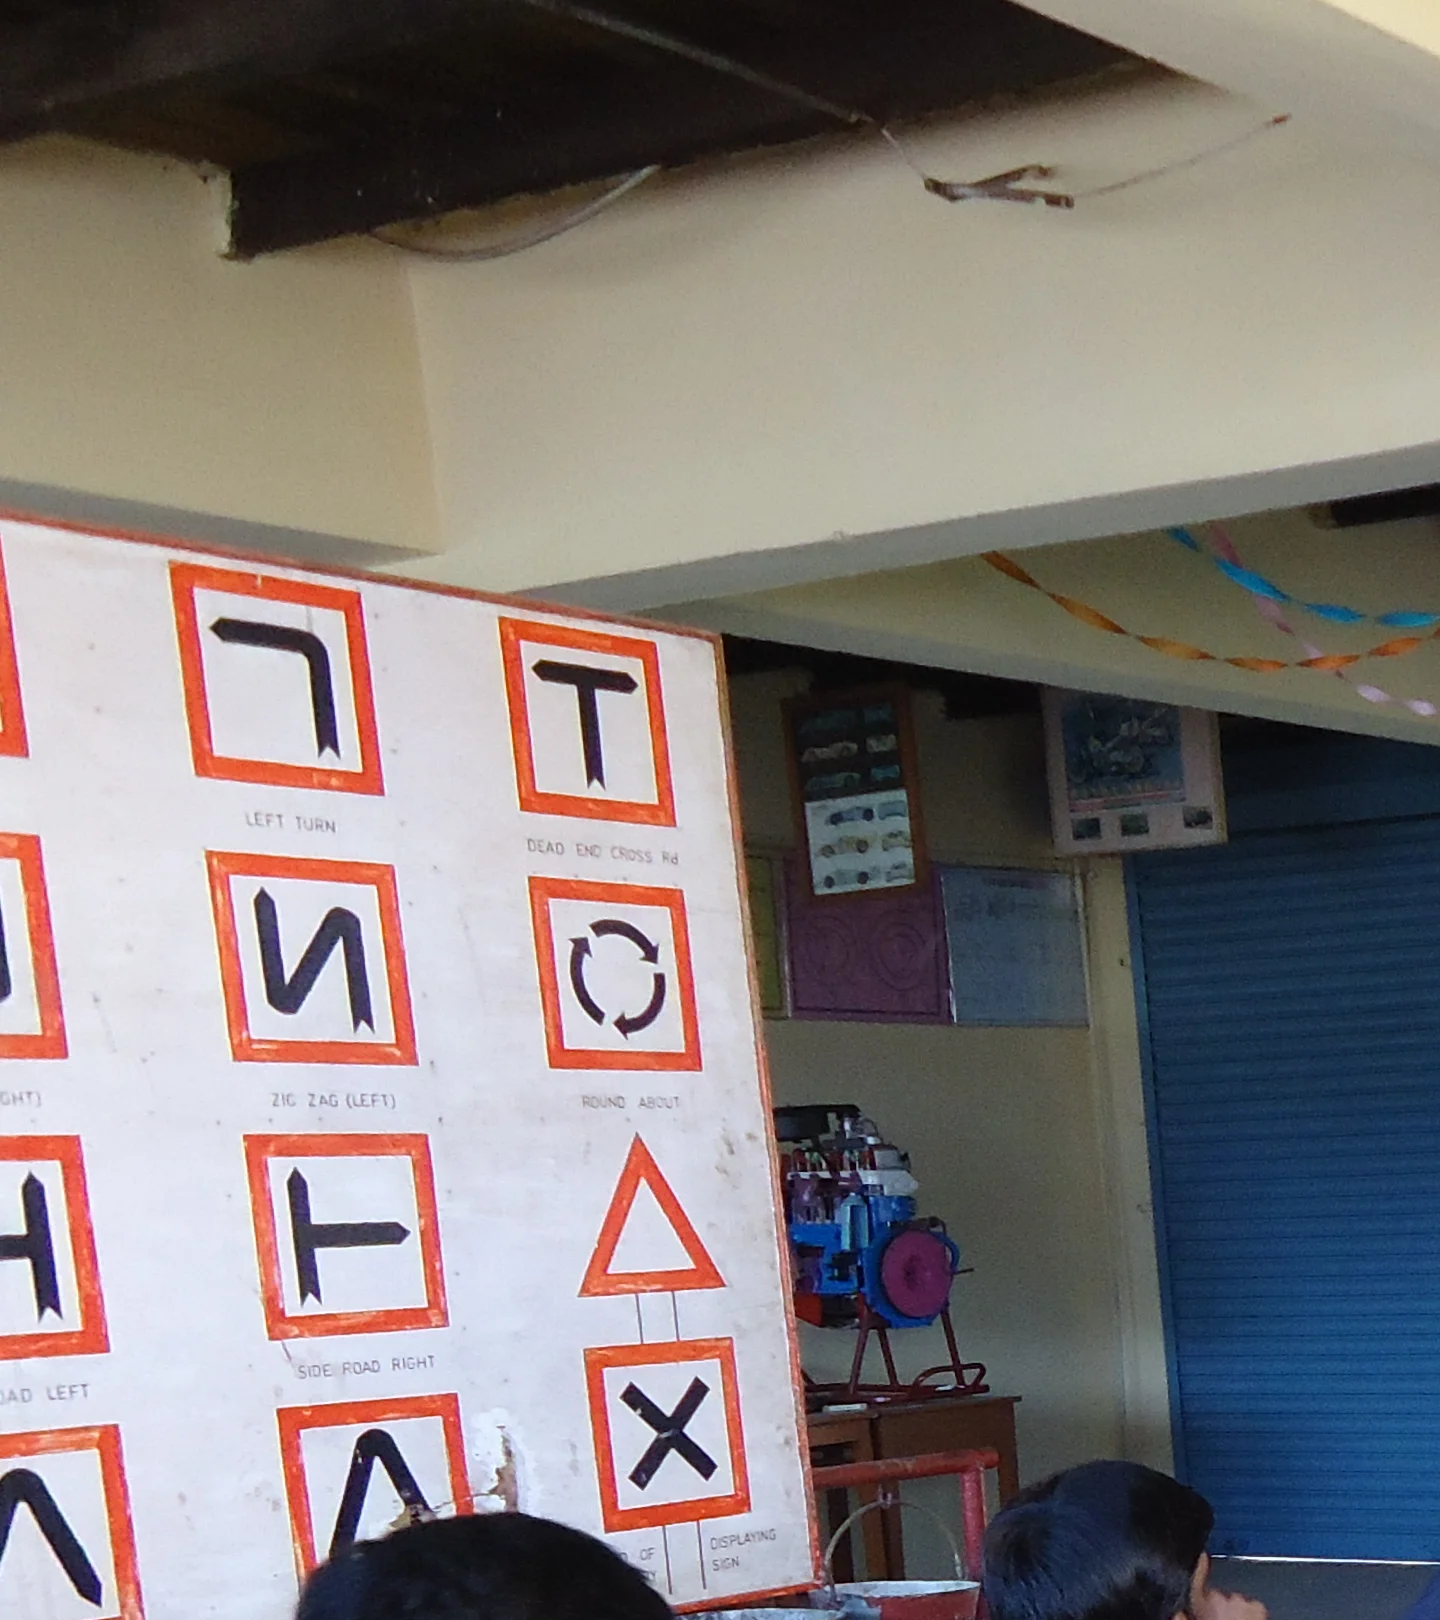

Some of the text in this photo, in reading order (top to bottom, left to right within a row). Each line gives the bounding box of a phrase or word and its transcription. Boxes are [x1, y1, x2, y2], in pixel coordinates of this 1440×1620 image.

[244, 811, 337, 833] LEFT TURN
[526, 838, 565, 856] DEAD
[575, 843, 602, 858] END
[610, 846, 653, 864] CROSS
[307, 1092, 339, 1108] ZAG
[345, 1092, 397, 1110] (LEFT)
[581, 1094, 680, 1109] ROUND ABOUT
[297, 1355, 435, 1380] SIDE ROAD RIGHT
[46, 1383, 90, 1401] LEFT
[710, 1528, 777, 1551] DISPLAYING
[640, 1547, 656, 1561] OF
[712, 1556, 740, 1572] SIGN
